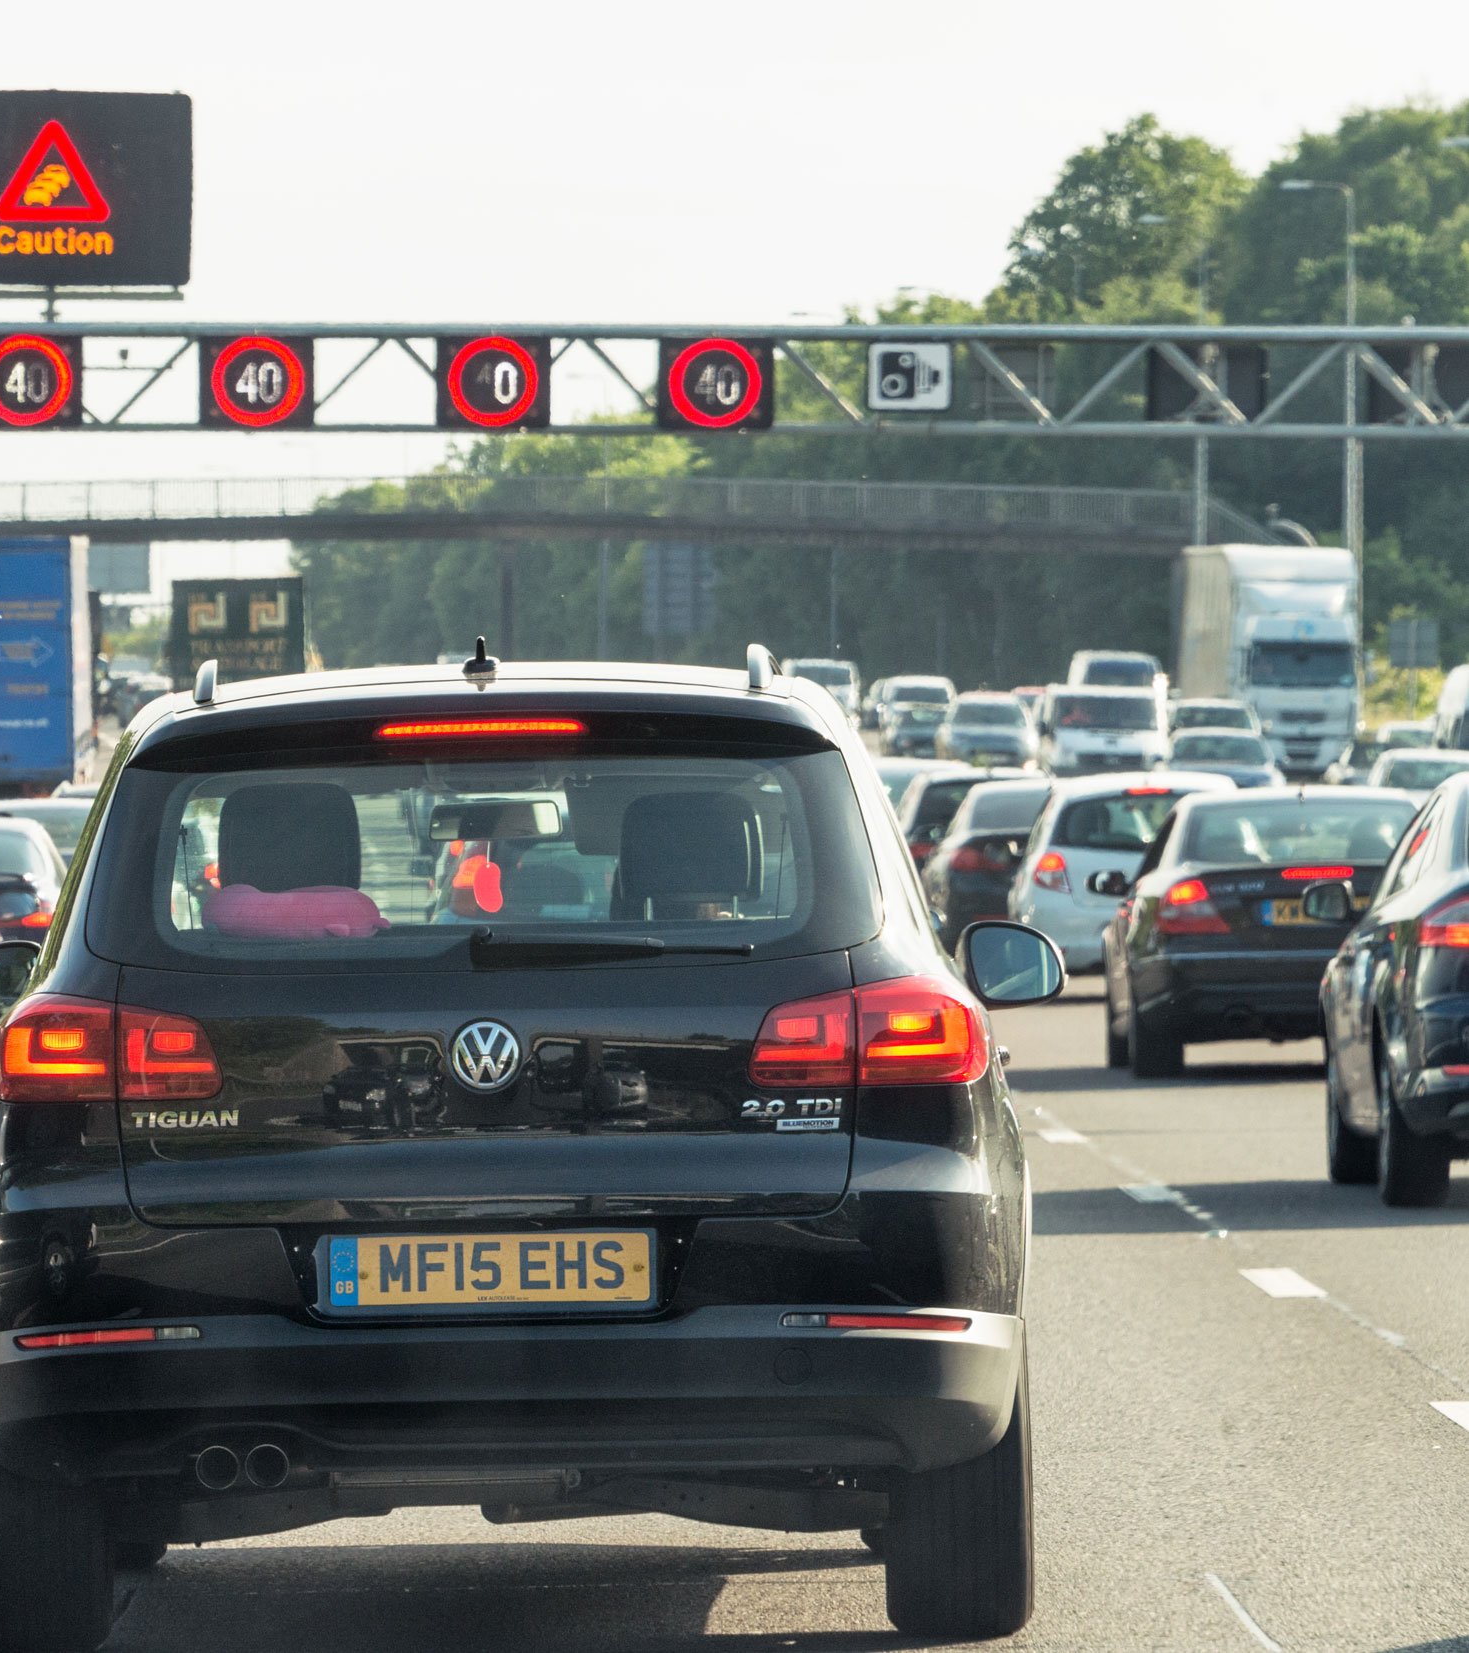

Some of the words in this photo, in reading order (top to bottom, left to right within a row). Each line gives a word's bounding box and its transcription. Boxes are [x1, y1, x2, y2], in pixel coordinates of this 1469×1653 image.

[5, 361, 49, 404] 40
[235, 361, 281, 404] 40
[694, 364, 741, 406] 40
[131, 1110, 239, 1128] TIGUAN
[741, 1099, 786, 1117] 2.0
[796, 1098, 842, 1115] TDI
[782, 1119, 834, 1127] BLUEMOTION
[379, 1242, 501, 1292] MF15
[519, 1240, 625, 1290] EHS
[335, 1281, 354, 1294] GB
